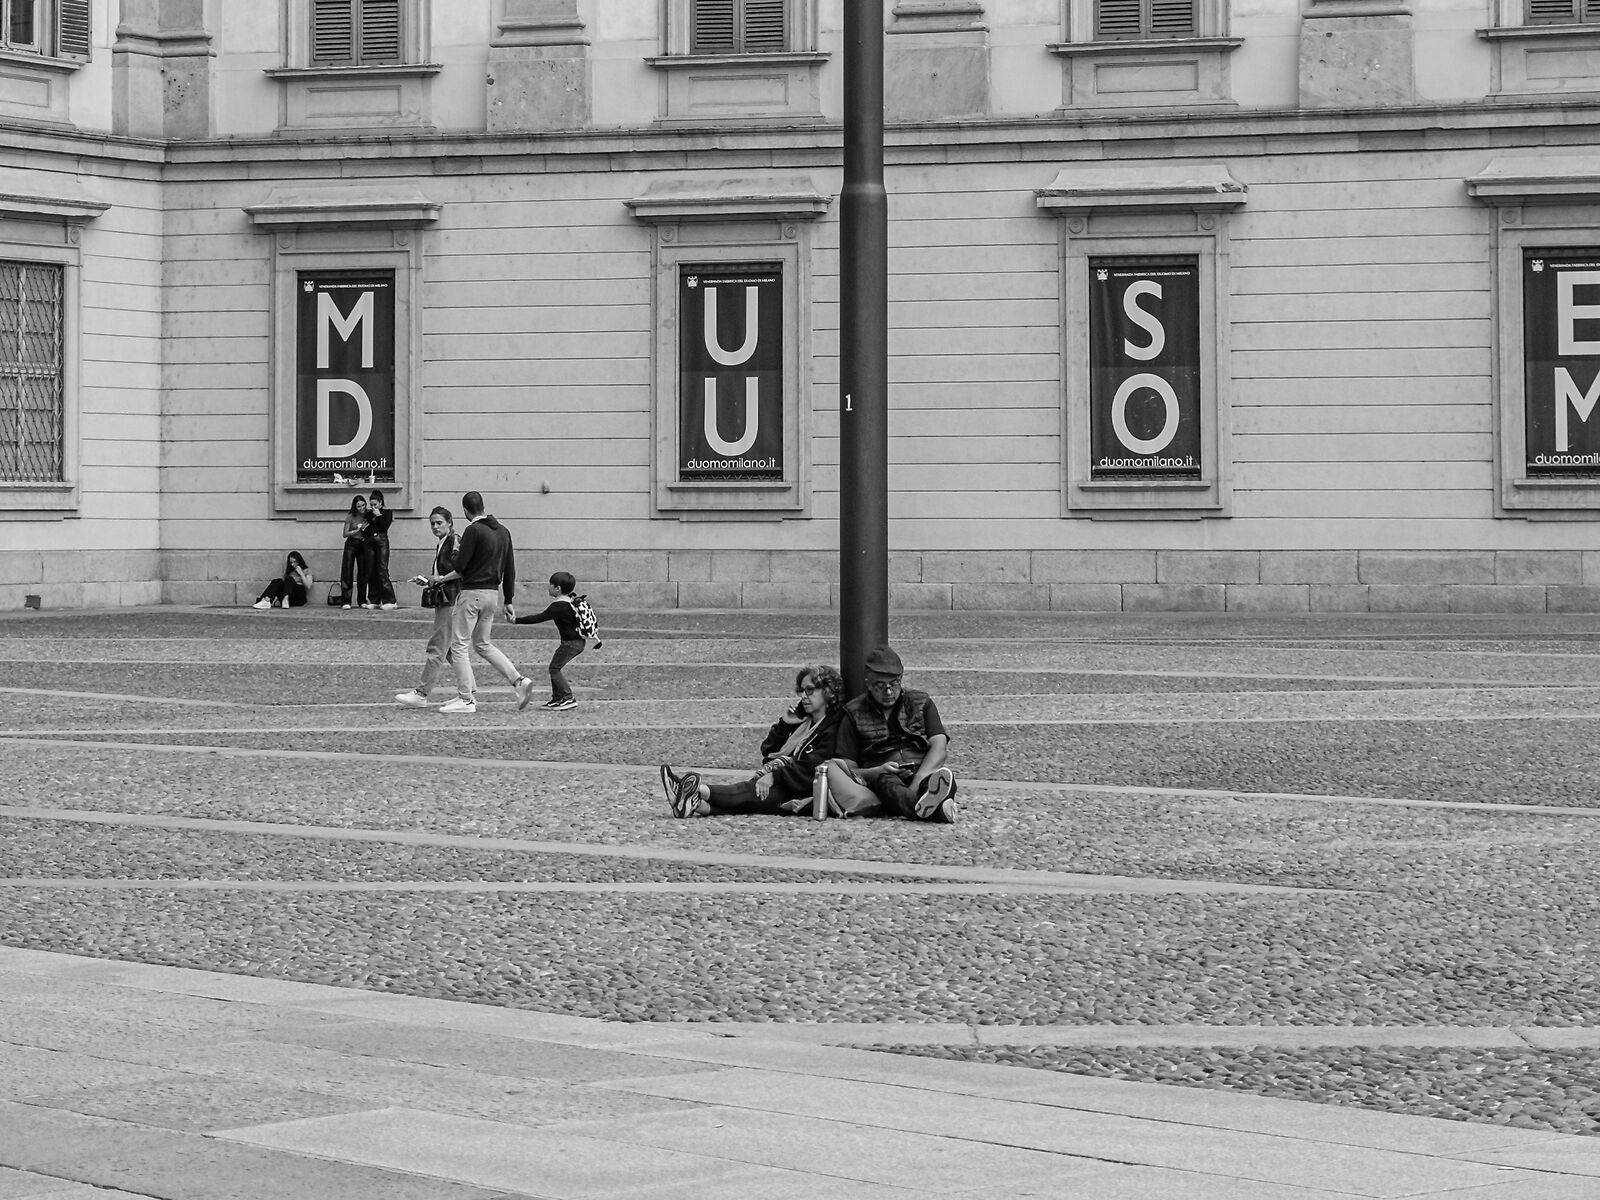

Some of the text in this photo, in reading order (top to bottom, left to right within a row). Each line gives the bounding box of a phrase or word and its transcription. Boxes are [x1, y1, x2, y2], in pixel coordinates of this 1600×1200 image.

[316, 291, 374, 369] M
[704, 285, 759, 366] U
[1122, 279, 1166, 361] S
[1556, 270, 1600, 356] E
[316, 378, 373, 458] D
[704, 376, 759, 457] U
[845, 393, 853, 412] 1
[1111, 372, 1180, 455] O
[1554, 366, 1600, 452] M
[303, 457, 387, 469] duomomilano.it
[687, 457, 776, 468] duomomilano.it
[1099, 455, 1193, 467] duomomilano.it
[1534, 452, 1600, 464] duomomil
